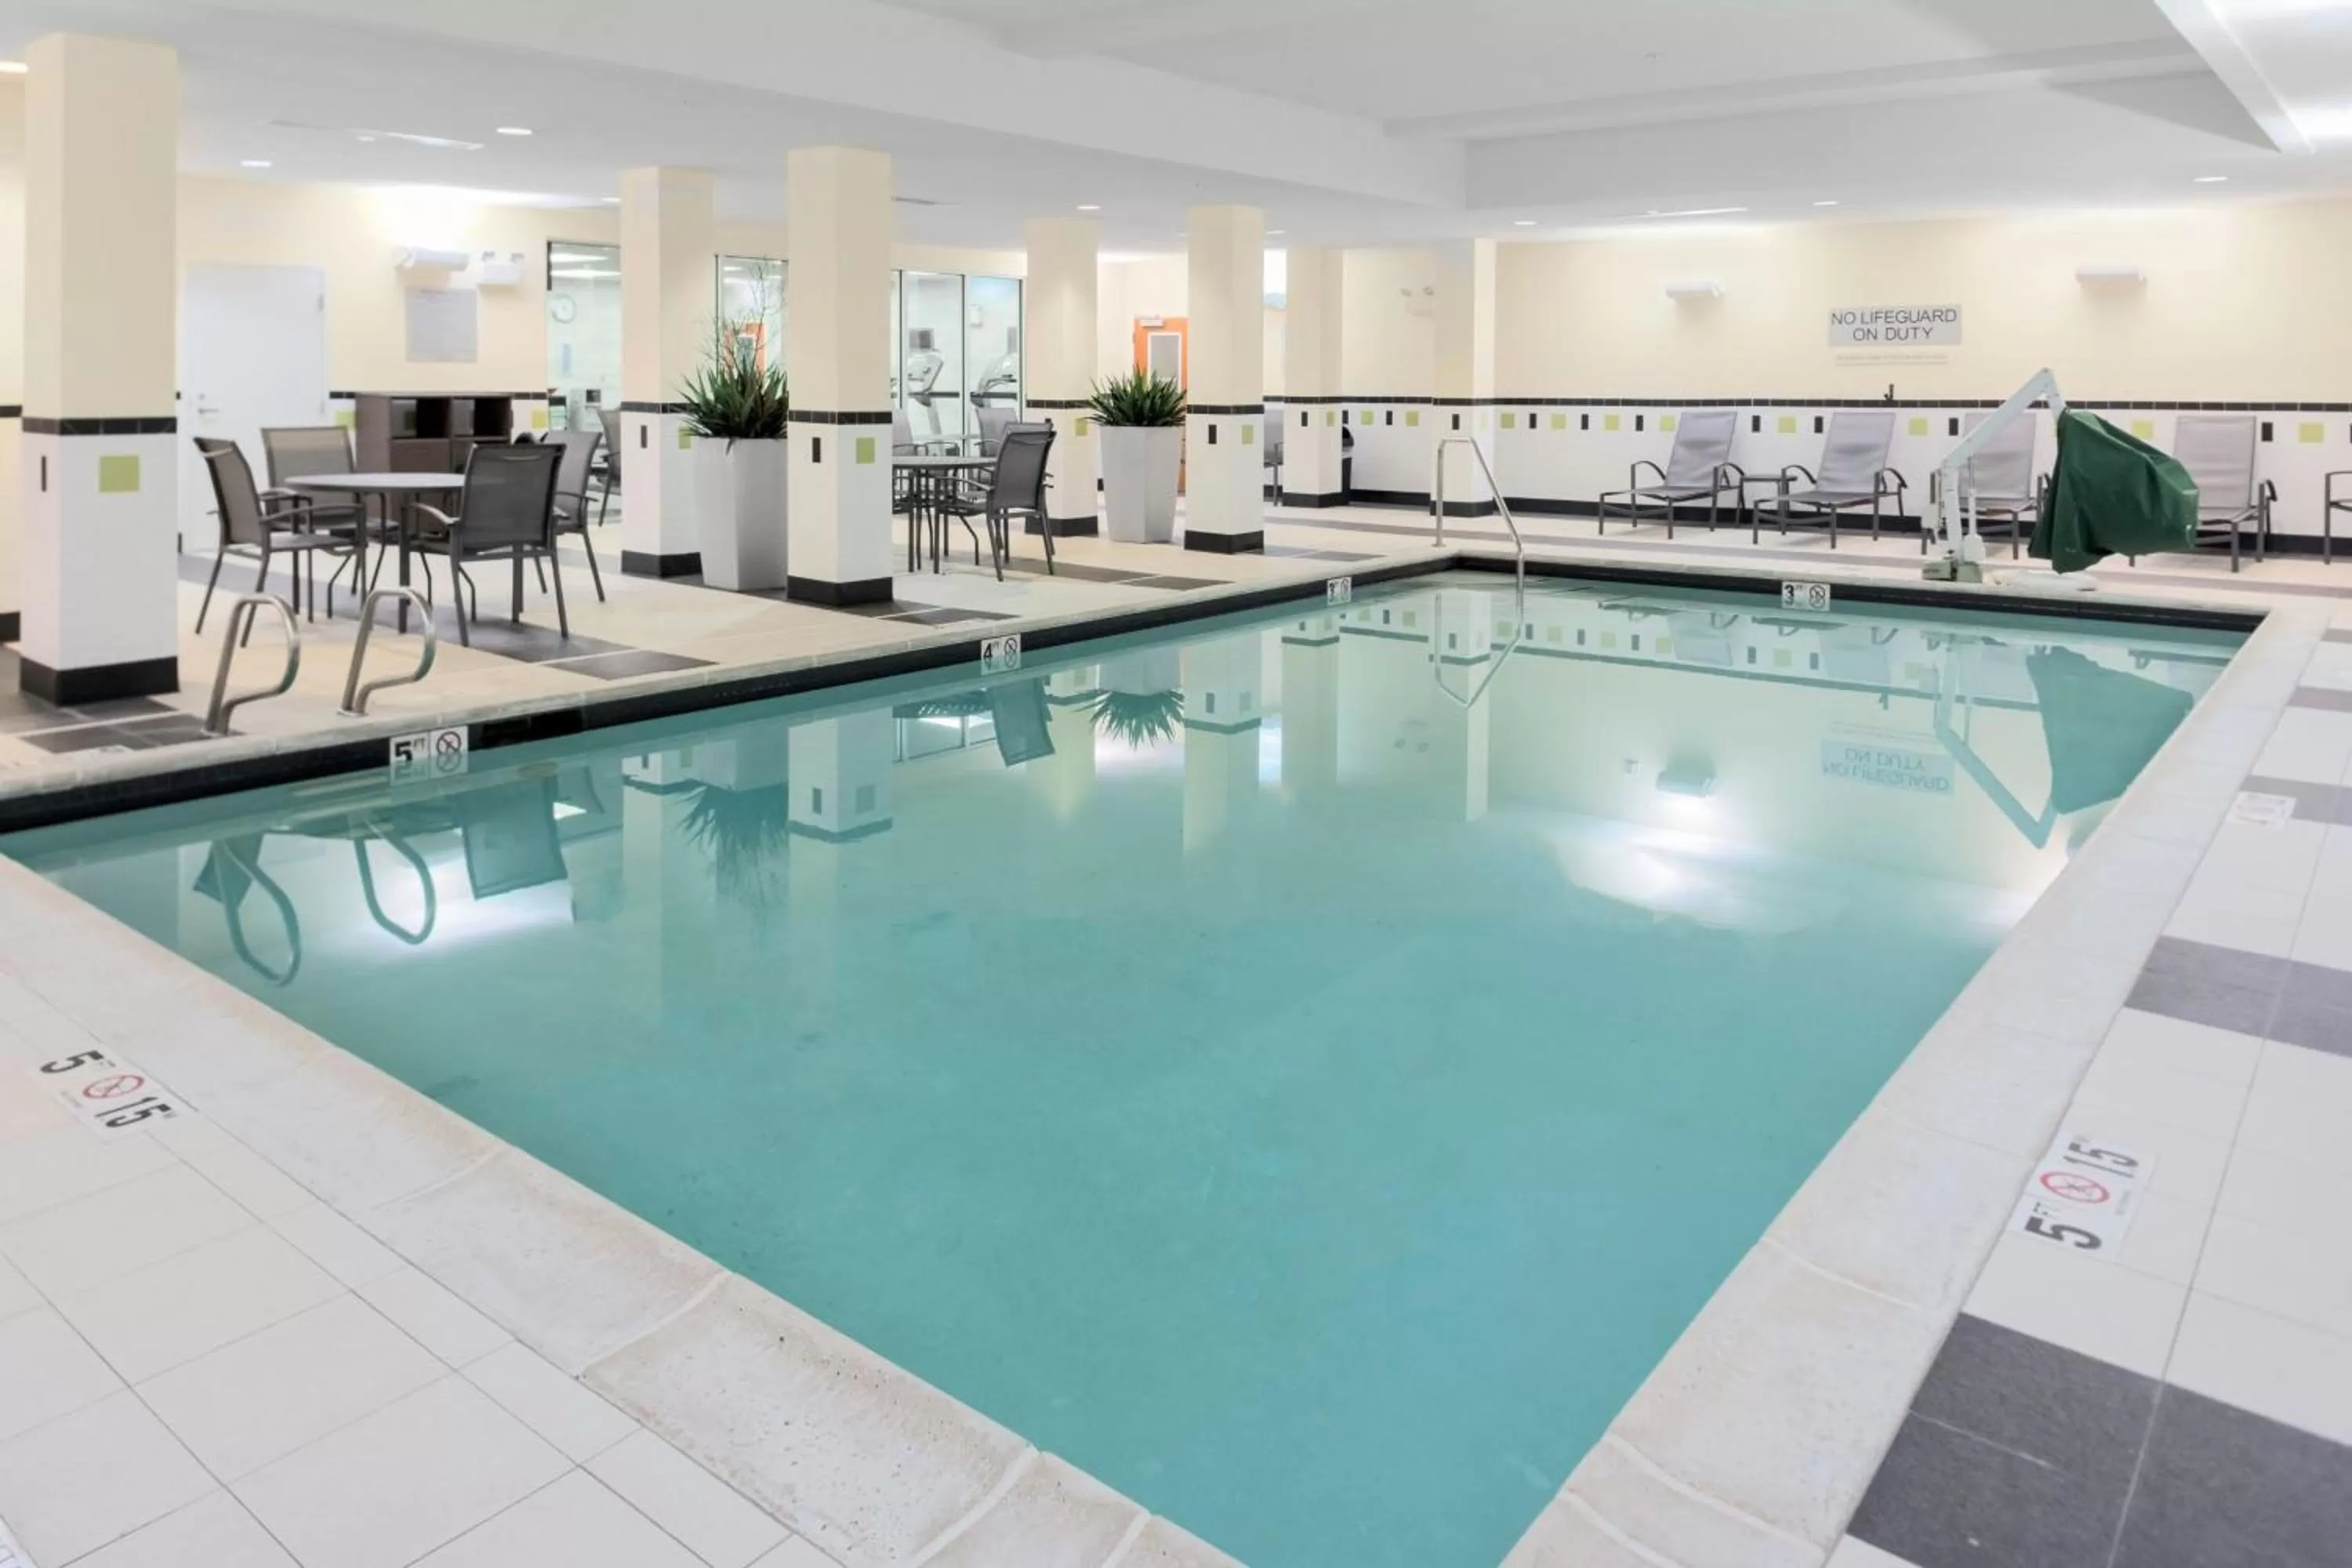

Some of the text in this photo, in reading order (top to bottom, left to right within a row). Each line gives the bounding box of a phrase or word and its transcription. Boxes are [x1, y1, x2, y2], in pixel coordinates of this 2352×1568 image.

[1831, 308, 1958, 325] NO LIFEGUARD
[1853, 325, 1934, 341] ON DUTY
[395, 740, 413, 762] 5
[41, 1049, 104, 1074] 5
[94, 1096, 172, 1127] 15
[2062, 1142, 2140, 1178] 15
[2024, 1215, 2103, 1250] 5
